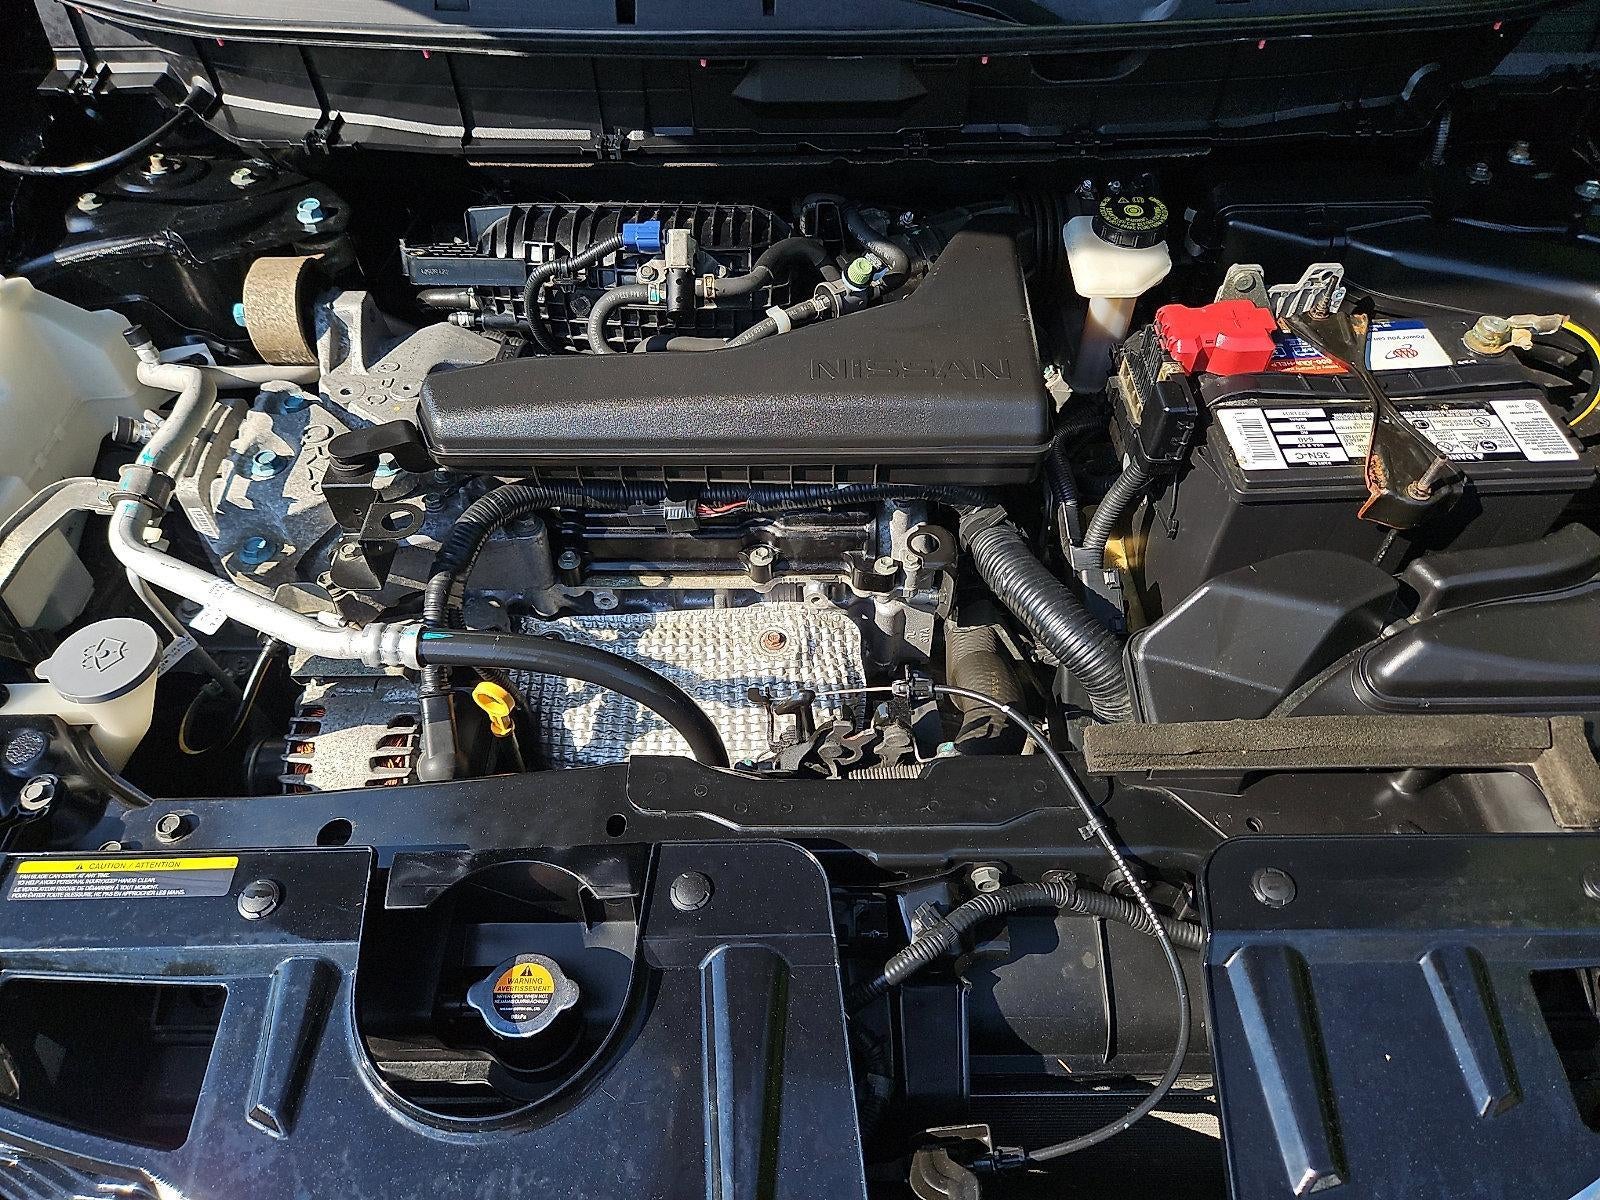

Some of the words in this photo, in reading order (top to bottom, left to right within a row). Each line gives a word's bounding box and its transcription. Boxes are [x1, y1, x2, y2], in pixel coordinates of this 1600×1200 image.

[810, 358, 1011, 380] NISSAN
[1294, 452, 1331, 460] 35N-C
[88, 862, 126, 870] CAUTION
